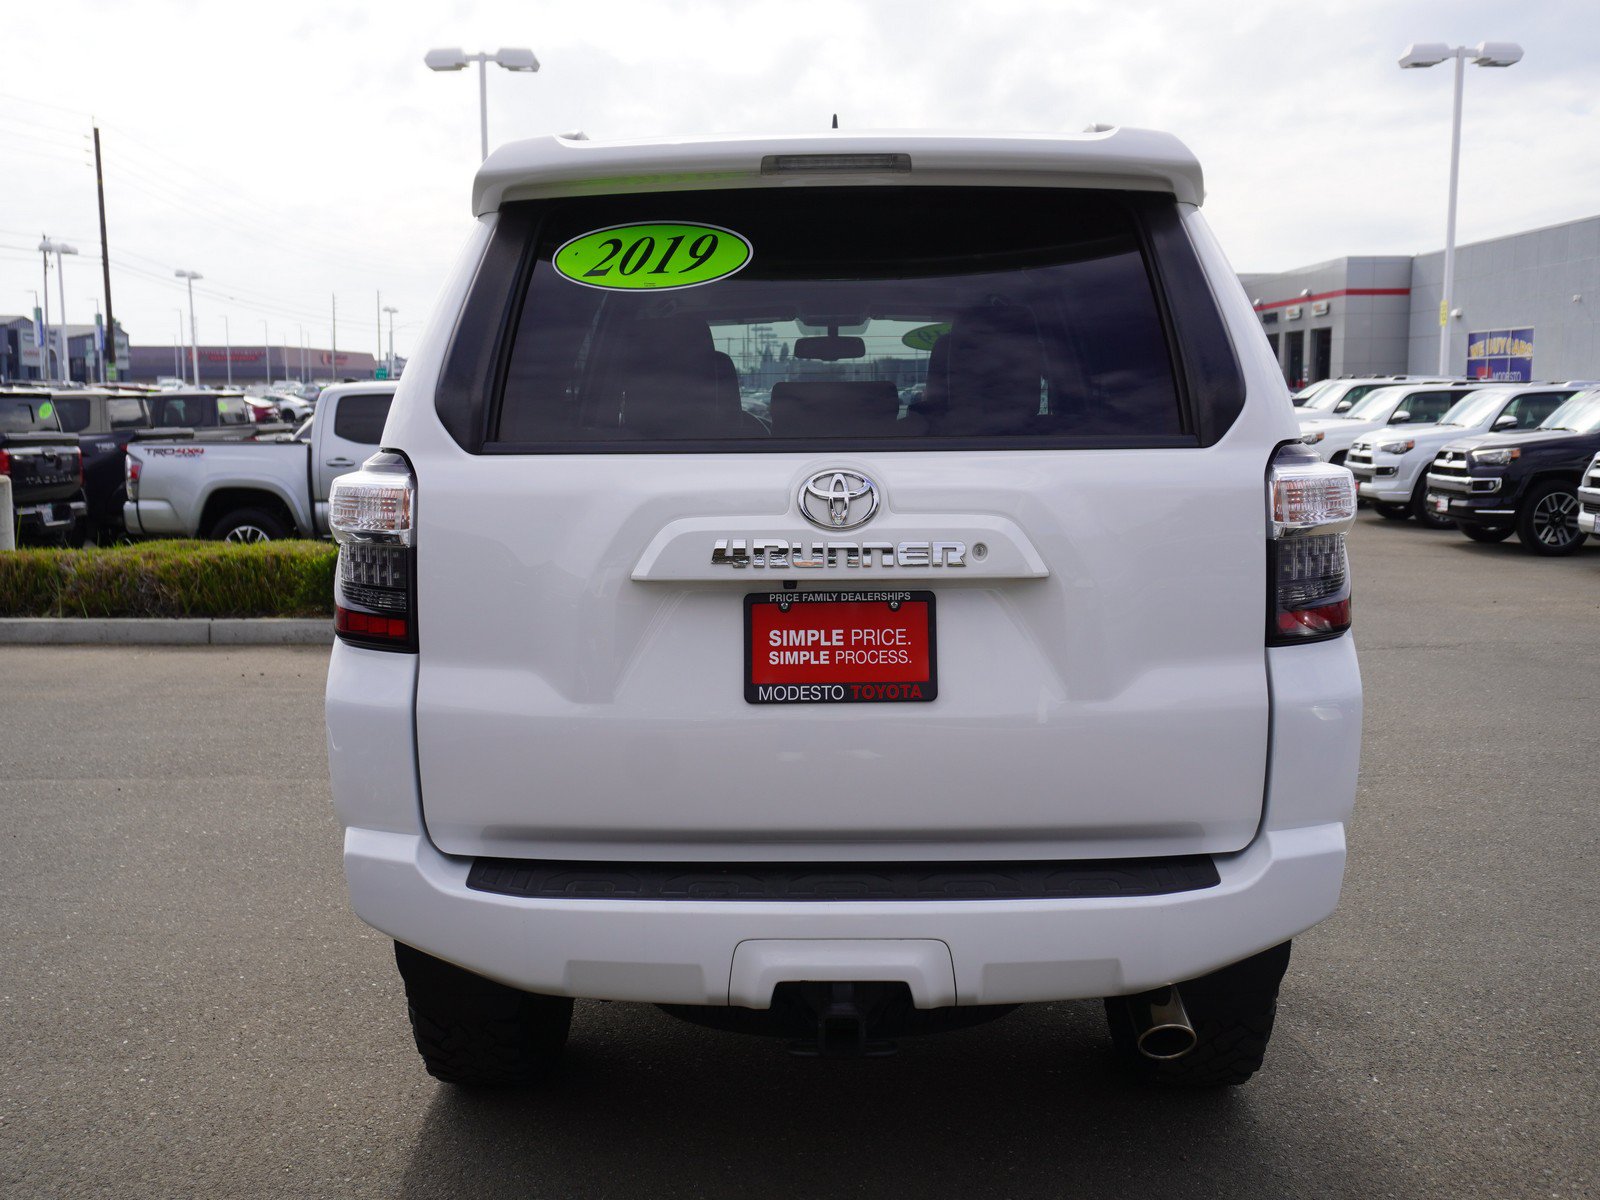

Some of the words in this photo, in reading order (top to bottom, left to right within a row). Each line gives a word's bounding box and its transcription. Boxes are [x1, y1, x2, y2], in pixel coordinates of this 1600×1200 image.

[582, 233, 719, 278] 2019
[1470, 340, 1485, 358] WE
[711, 538, 967, 568] 4RUNNER
[769, 593, 801, 602] PRICE
[802, 592, 839, 602] FAMILY
[840, 591, 912, 601] DEALERSHIPS
[768, 629, 844, 647] SIMPLE
[851, 628, 912, 646] PRICE.
[768, 650, 830, 665] SIMPLE
[835, 649, 912, 665] PROCESS.
[758, 684, 845, 702] MODESTO
[850, 684, 923, 699] TOYOTA
